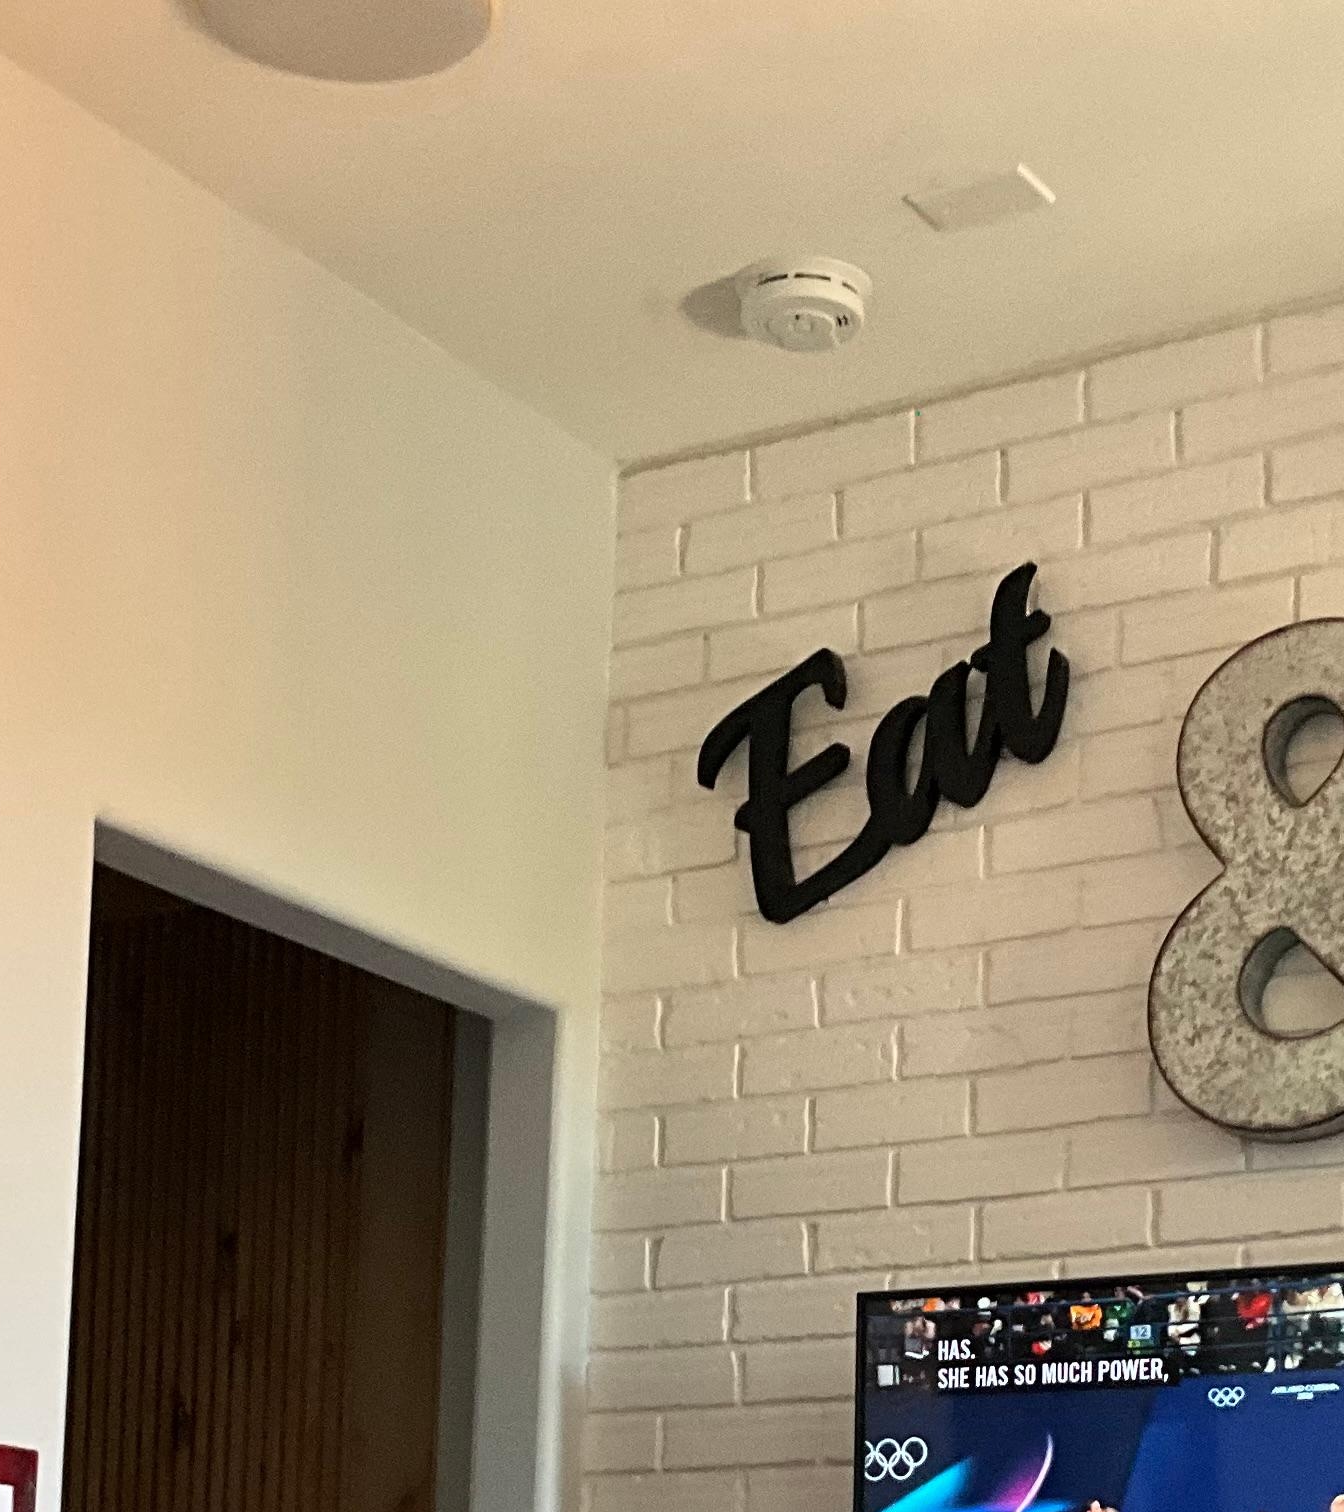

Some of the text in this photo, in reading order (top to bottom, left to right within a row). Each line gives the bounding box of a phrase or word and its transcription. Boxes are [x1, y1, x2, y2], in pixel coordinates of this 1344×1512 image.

[698, 561, 1071, 926] Eat
[937, 1339, 976, 1361] HAS.
[937, 1358, 1170, 1389] SHE HAS SO MUCH POWER,
